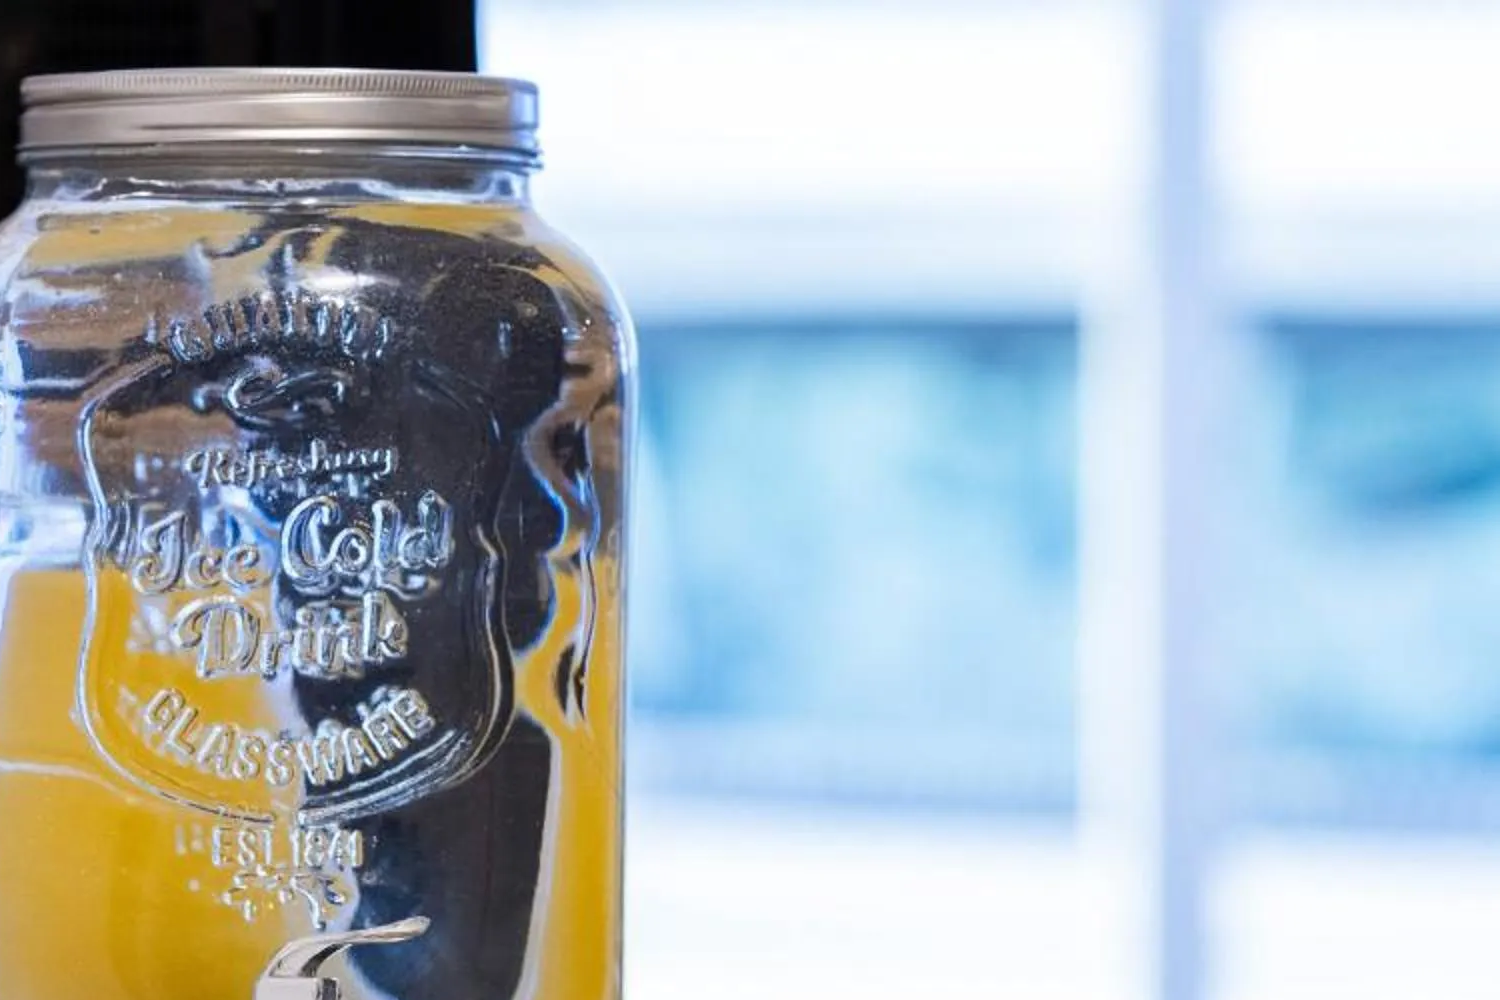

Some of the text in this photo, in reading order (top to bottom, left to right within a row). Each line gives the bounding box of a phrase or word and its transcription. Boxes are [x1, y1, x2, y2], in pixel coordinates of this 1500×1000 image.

[132, 490, 455, 598] Ice Cold
[170, 588, 408, 680] Drink
[143, 688, 437, 787] GLASSWARE
